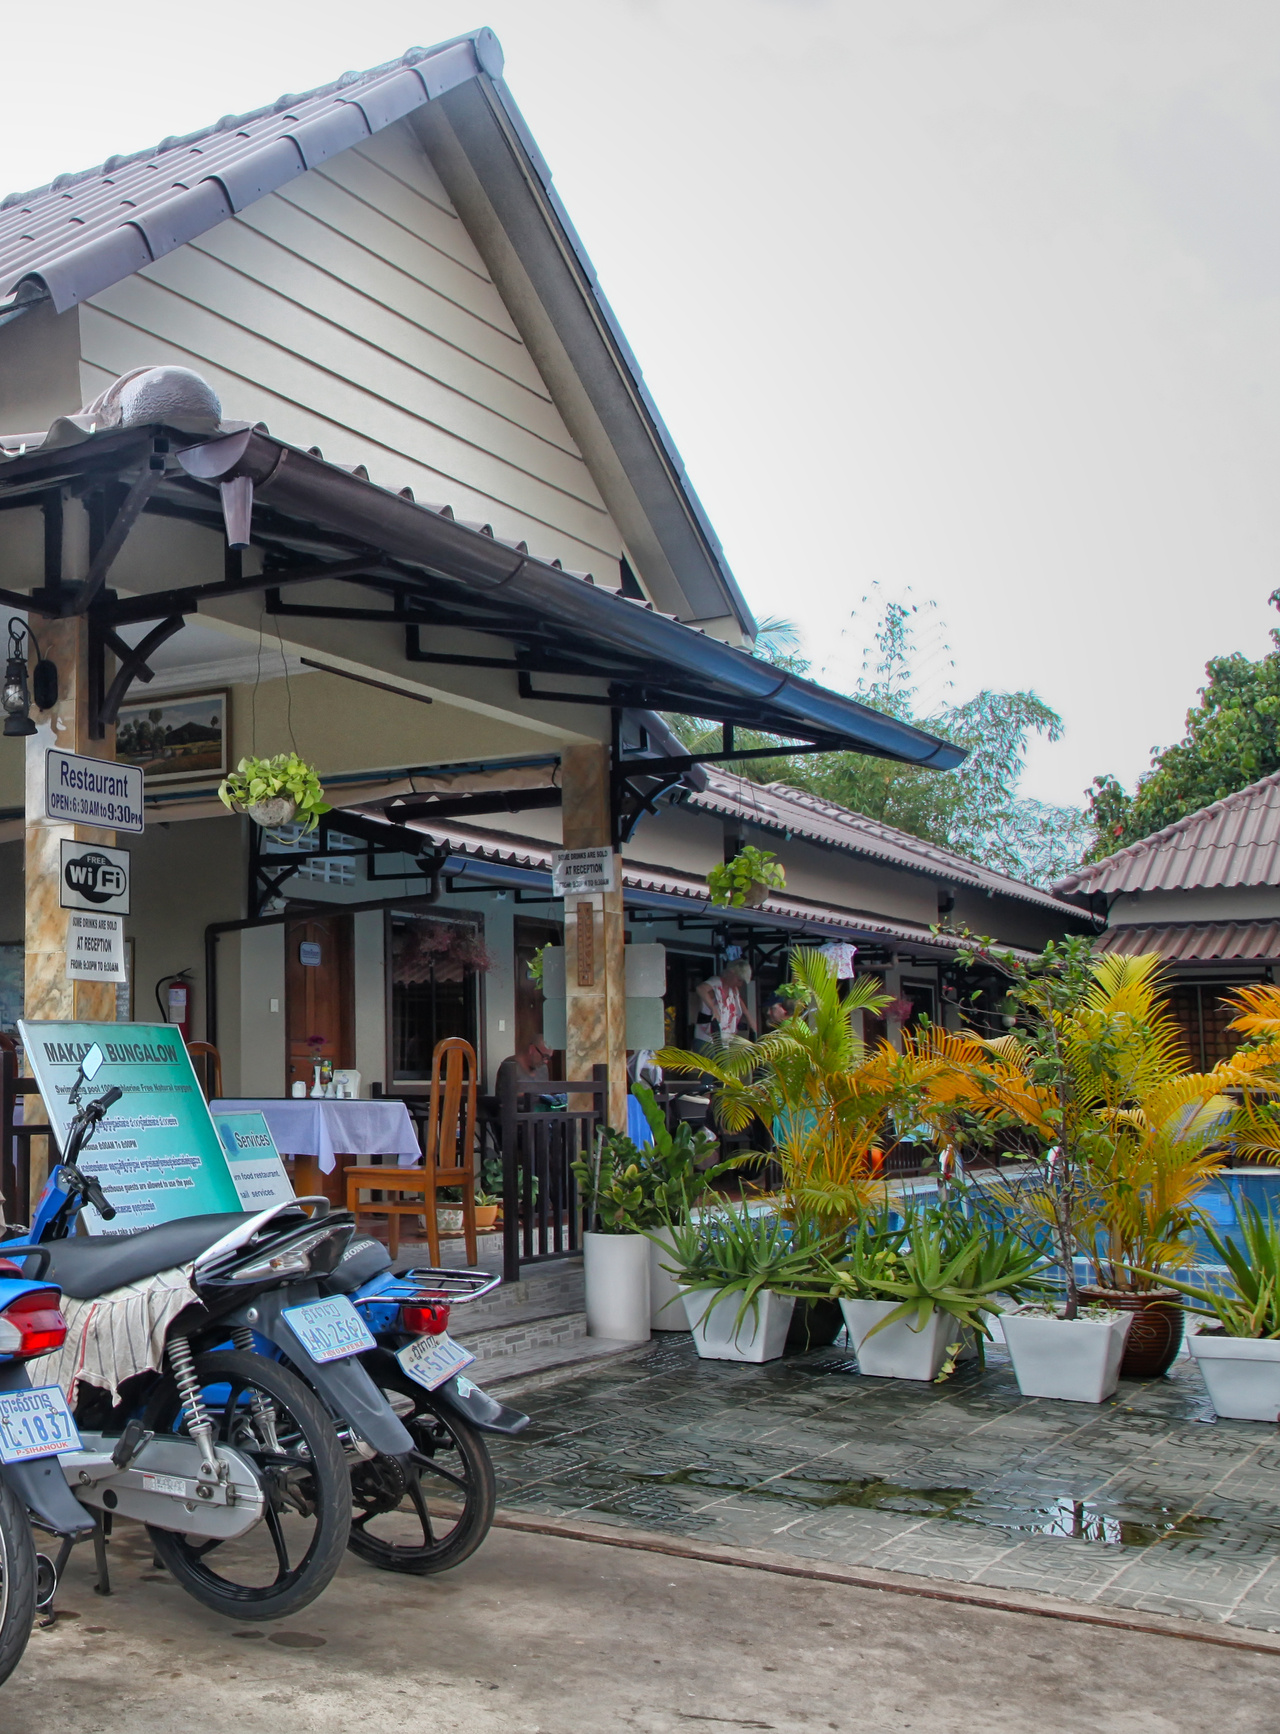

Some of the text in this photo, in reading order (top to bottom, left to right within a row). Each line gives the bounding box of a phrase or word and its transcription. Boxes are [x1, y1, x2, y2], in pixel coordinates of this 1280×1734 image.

[61, 760, 128, 798] Restaurant
[87, 856, 106, 865] FREE
[571, 852, 586, 860] DRINKS
[587, 851, 595, 859] ARE
[596, 850, 608, 858] SOLD
[565, 863, 603, 875] AT RECEPTION
[83, 918, 98, 929] DRINKS
[98, 920, 107, 930] ARE
[107, 921, 117, 931] SOLD
[77, 936, 112, 952] AT RECEPTION
[98, 962, 103, 971] TO
[43, 1042, 178, 1062] MAKA BUNGALOW
[88, 1084, 101, 1094] pool
[140, 1084, 153, 1092] Free
[154, 1083, 173, 1092] Natural
[234, 1131, 271, 1148] Services
[241, 1172, 254, 1180] food
[102, 1184, 124, 1193] uesthouse
[124, 1182, 139, 1194] guests
[147, 1180, 163, 1190] allowed
[163, 1180, 169, 1188] to
[16, 1441, 69, 1455] P-SIHANOUK
